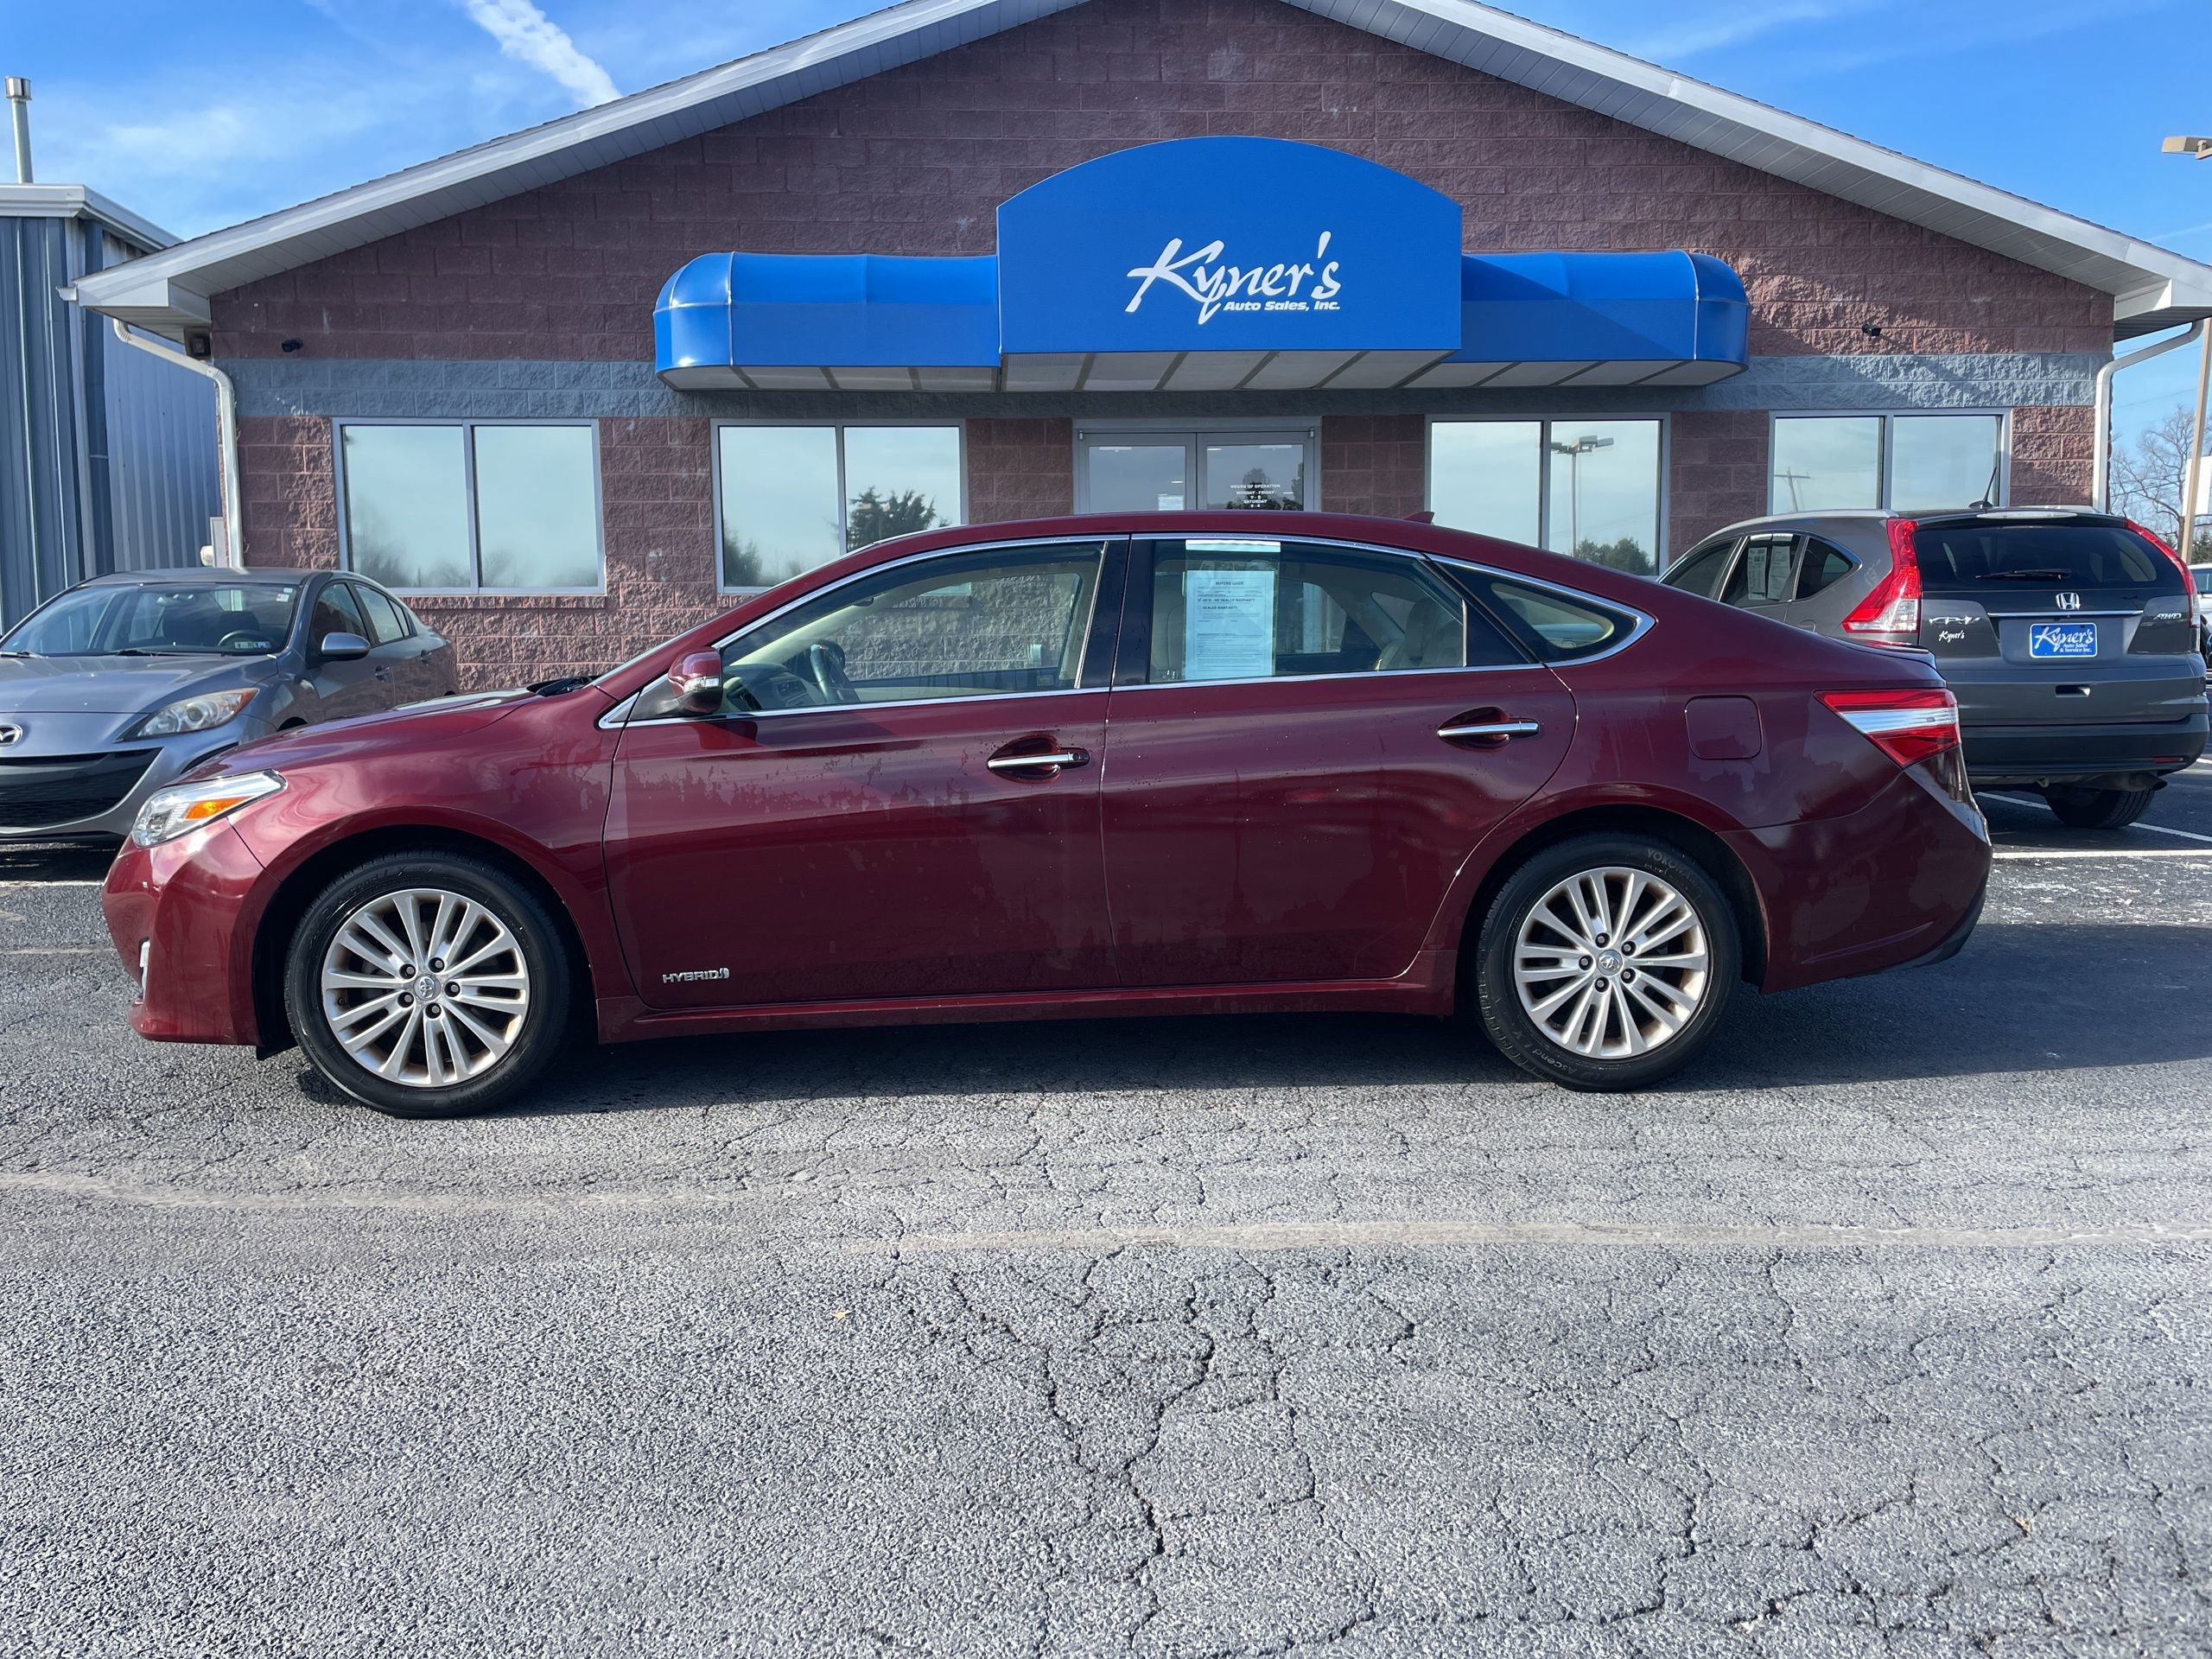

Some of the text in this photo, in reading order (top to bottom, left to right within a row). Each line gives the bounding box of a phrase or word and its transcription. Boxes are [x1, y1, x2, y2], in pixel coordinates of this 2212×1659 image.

[1124, 230, 1341, 325] Kyner's
[1224, 301, 1341, 312] Auto Sales, Inc.
[1939, 630, 1965, 643] Kyner's
[2034, 626, 2094, 652] Kyner's
[663, 969, 719, 983] HYBRID
